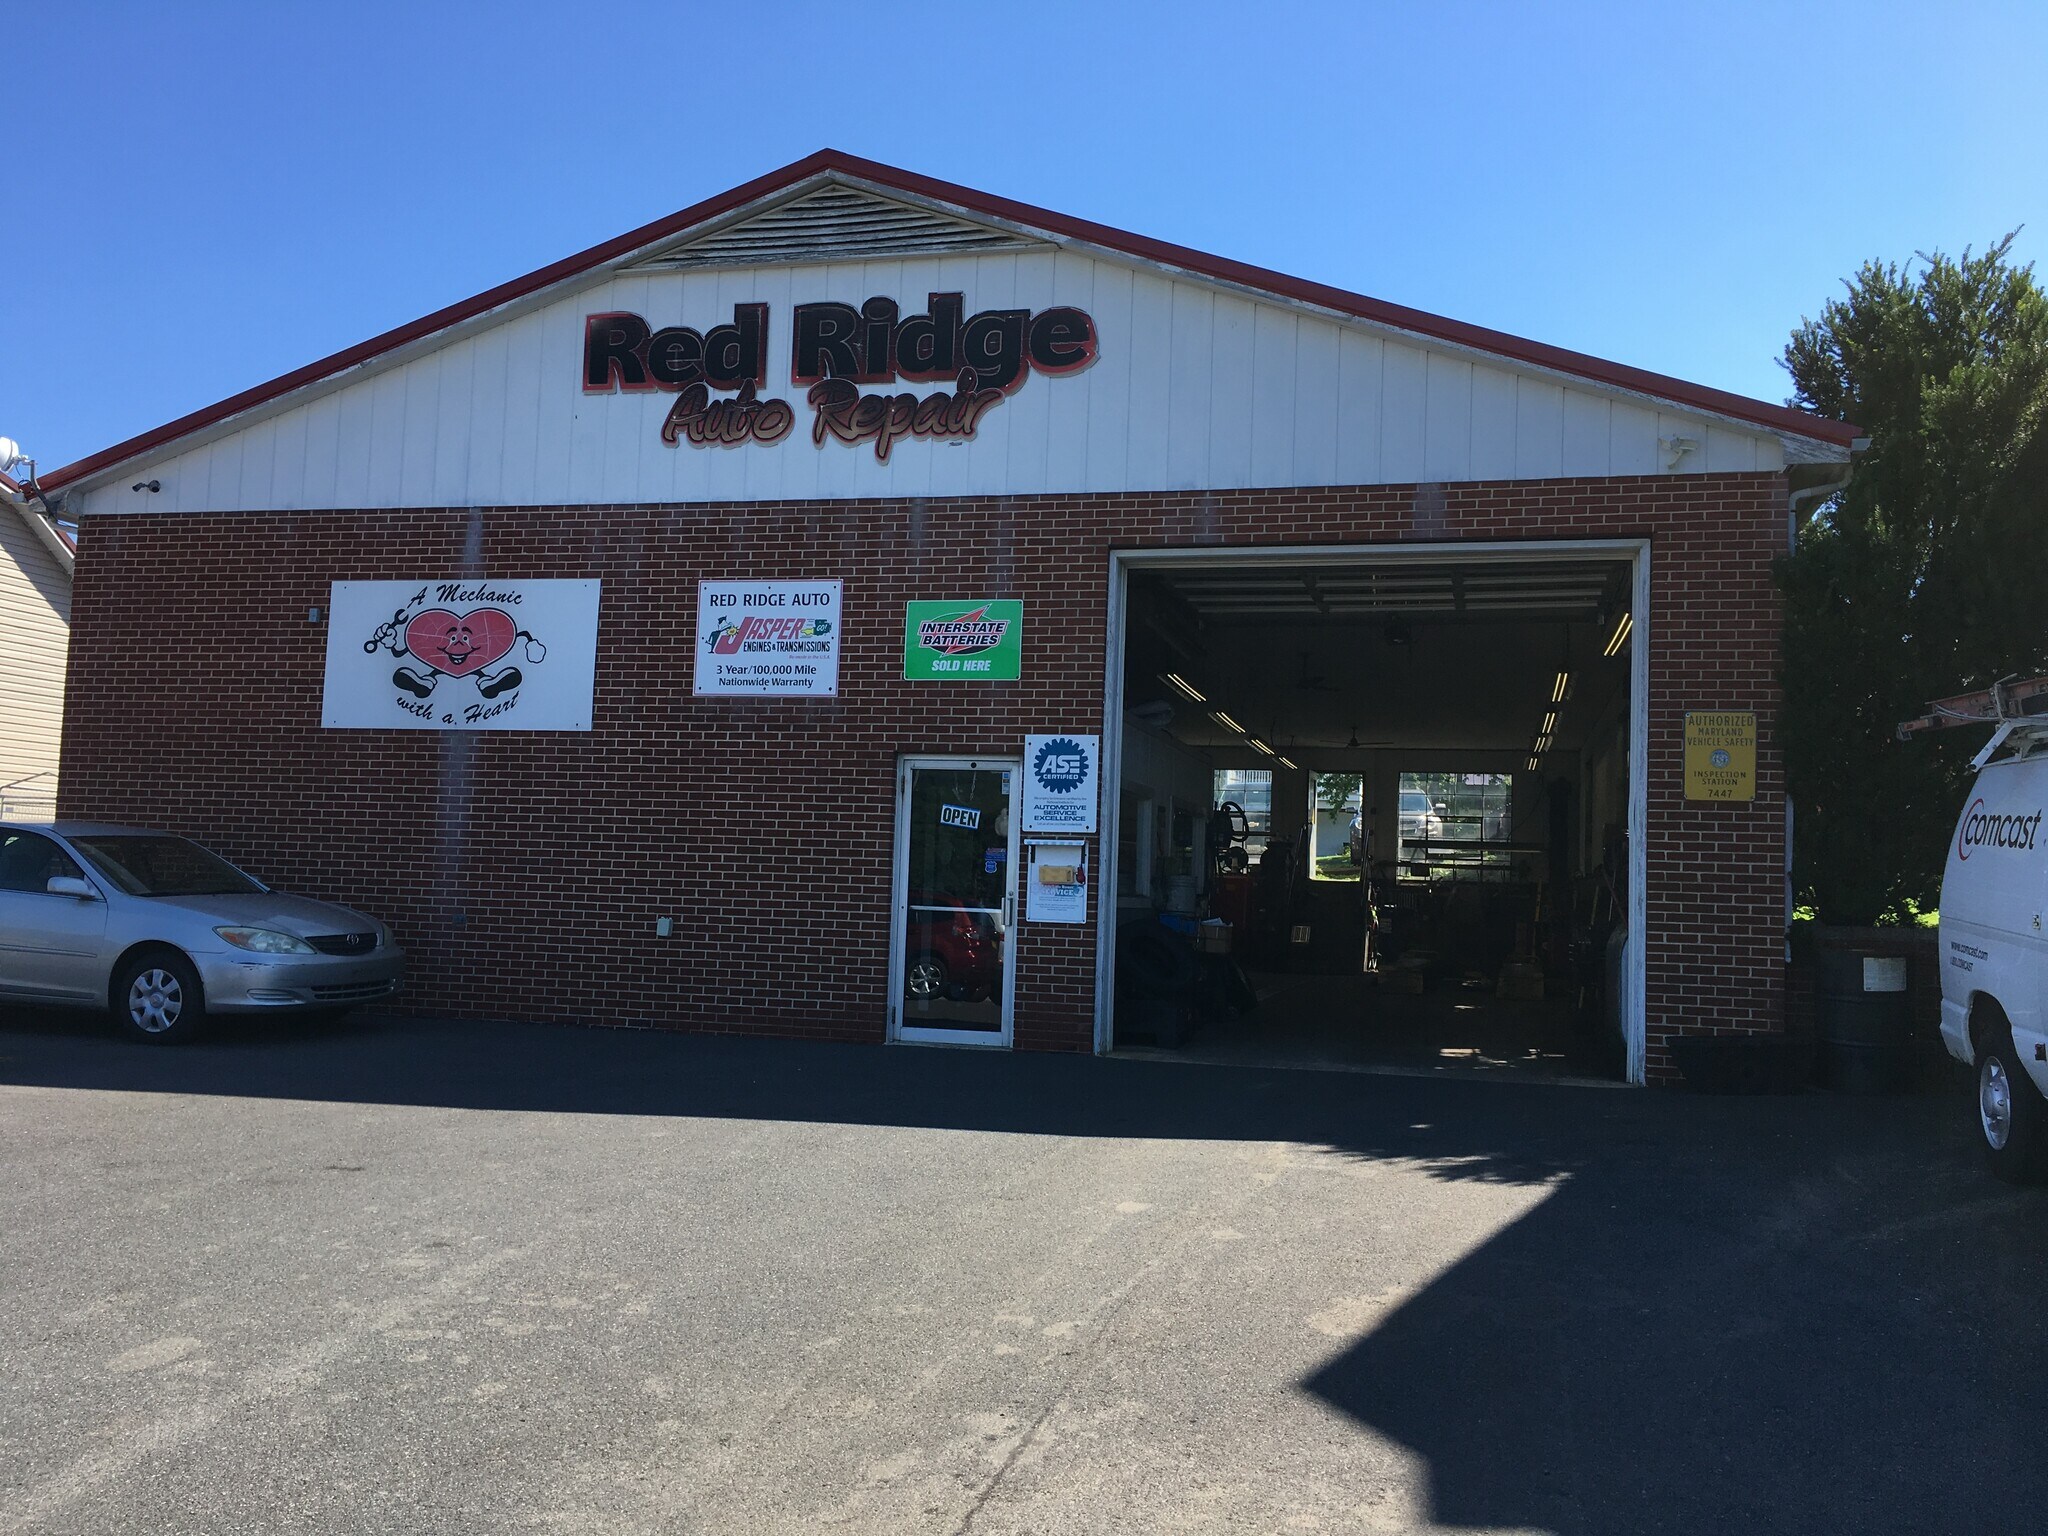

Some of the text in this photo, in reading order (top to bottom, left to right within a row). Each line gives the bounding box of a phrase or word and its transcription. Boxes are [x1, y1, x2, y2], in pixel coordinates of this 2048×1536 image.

[585, 291, 1100, 398] Red Ridge
[661, 367, 1005, 465] Auto Repair
[407, 583, 523, 609] A Mechanic
[710, 593, 830, 607] RED RIDGE AUTO
[920, 622, 1005, 633] INTERSTATE
[714, 616, 807, 655] JASPER
[923, 635, 998, 645] BATTERIES
[716, 664, 817, 676] 3 Year/100,000 Mile
[931, 660, 992, 672] SOLD HERE
[718, 677, 814, 689] Nationwide Warranty
[396, 696, 434, 721] with
[465, 691, 520, 725] Heart
[1688, 715, 1754, 727] AUTHORIZED
[1698, 727, 1744, 737] MARYLAND
[1687, 737, 1755, 747] VEHICLE SAFETY
[1040, 754, 1081, 774] ASE
[1693, 770, 1747, 779] INSPECTION
[1702, 778, 1738, 786] STATION
[1708, 789, 1733, 799] 7447
[942, 807, 978, 827] OPEN
